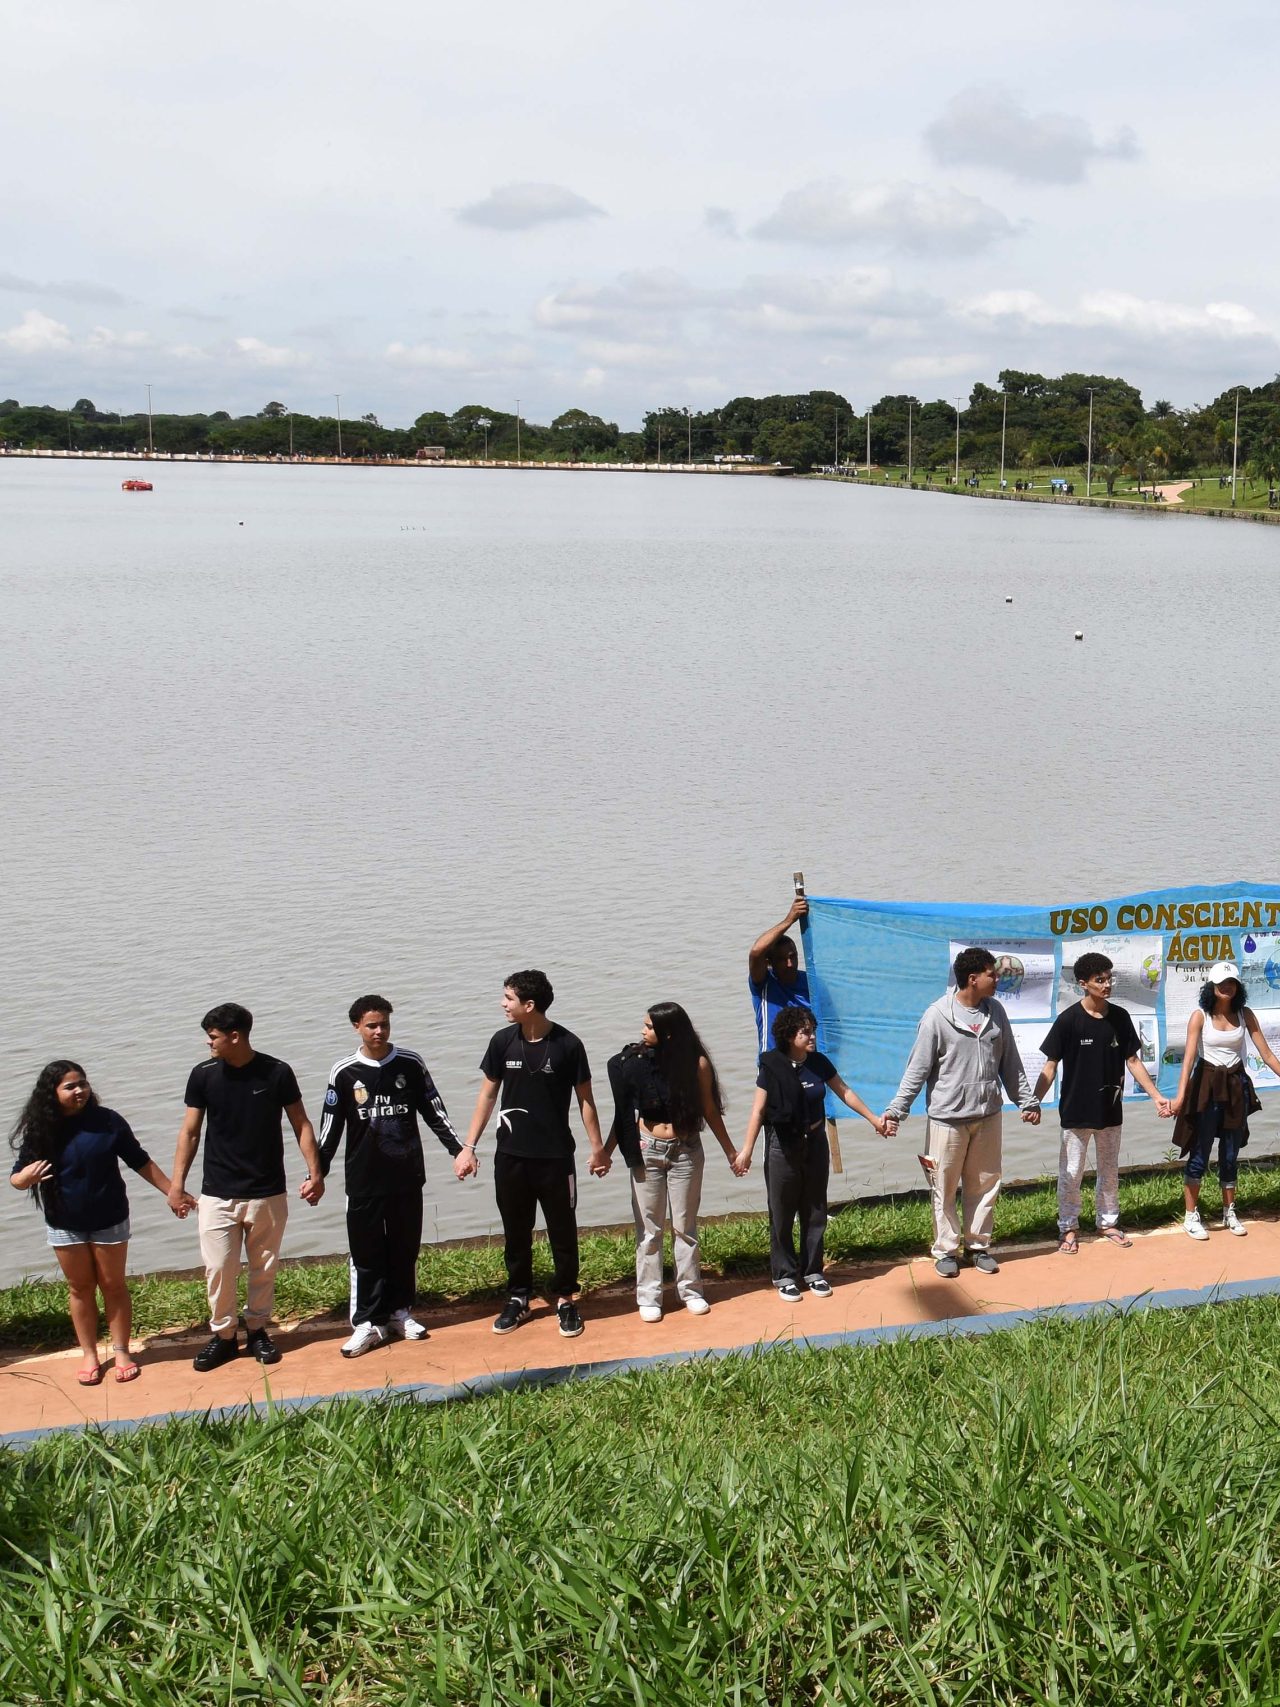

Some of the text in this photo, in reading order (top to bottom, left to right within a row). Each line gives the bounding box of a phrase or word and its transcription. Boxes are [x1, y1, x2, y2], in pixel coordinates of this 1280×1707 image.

[1049, 906, 1109, 936] USO
[1166, 930, 1236, 962] ÁGUA
[357, 1104, 408, 1120] Emirates
[375, 1095, 391, 1106] Fly
